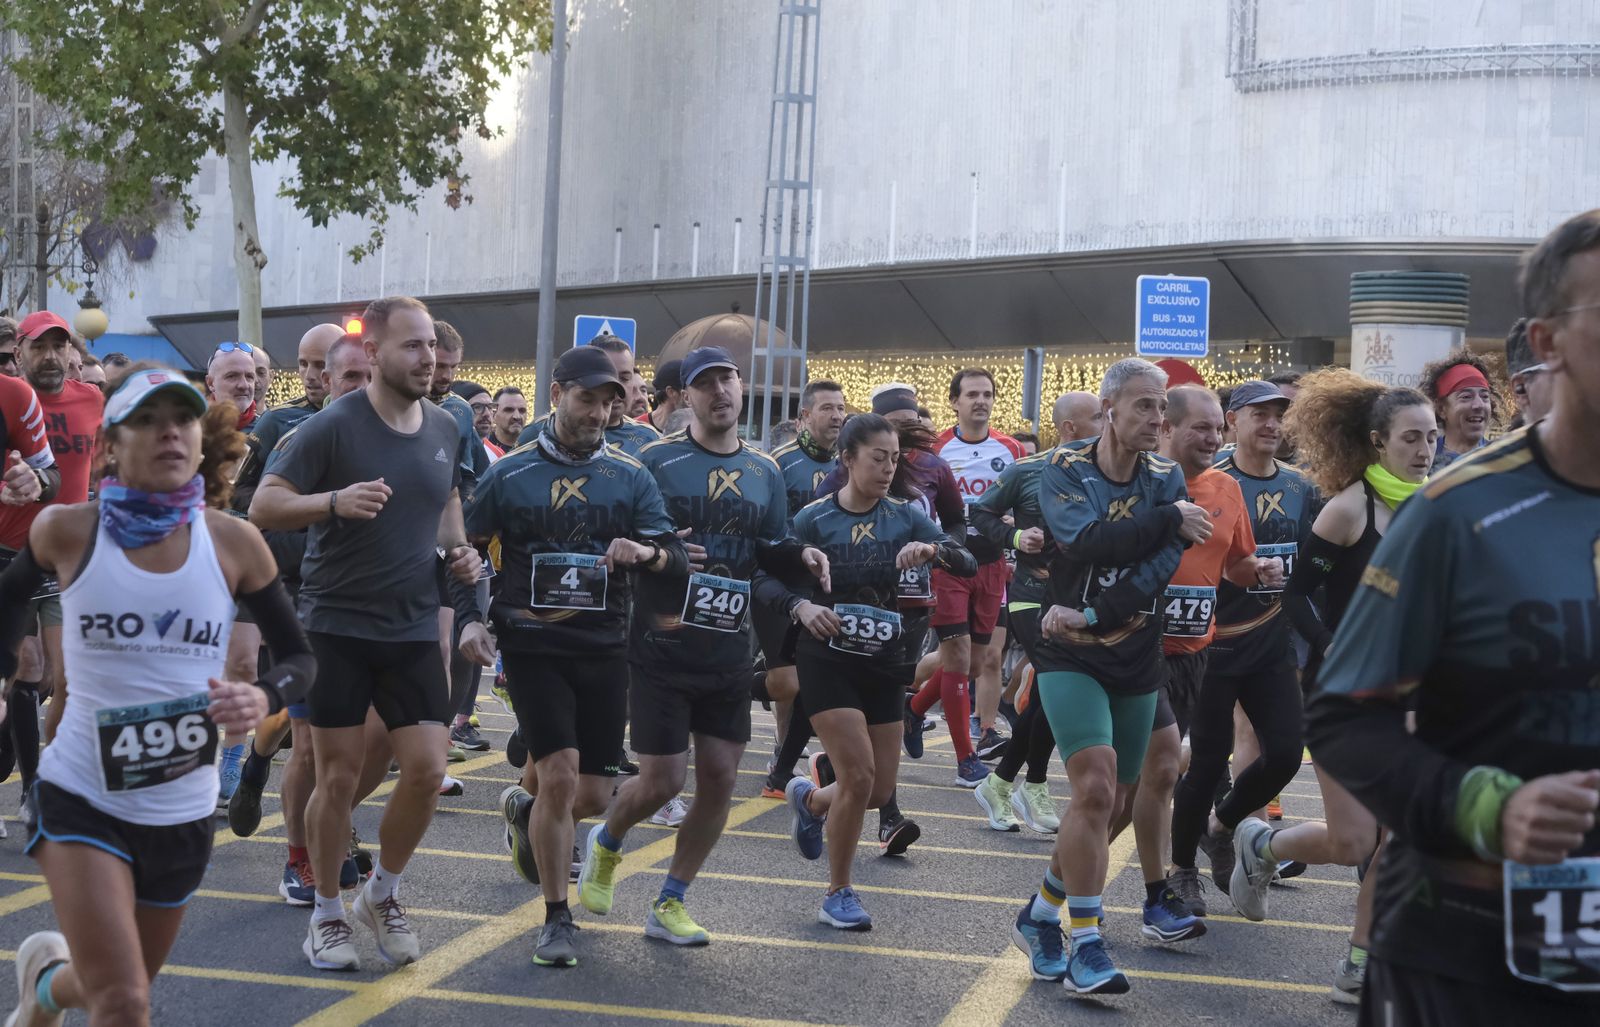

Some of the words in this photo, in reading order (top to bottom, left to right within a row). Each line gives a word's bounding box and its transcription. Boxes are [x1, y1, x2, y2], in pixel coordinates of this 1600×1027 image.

[1156, 282, 1192, 293] CARRIL
[1147, 295, 1200, 306] EXCLUSIVO
[1152, 313, 1171, 322] BUS
[1177, 314, 1195, 323] TAXI
[1141, 327, 1198, 337] AUTORIZADOS
[1199, 329, 1206, 337] Y
[1141, 341, 1205, 352] MOTOCICLETAS
[1383, 373, 1394, 386] DE
[596, 464, 617, 479] SIG
[745, 459, 763, 477] SIG
[550, 476, 590, 512] IX
[707, 466, 744, 503] IX
[1286, 479, 1300, 494] SIG
[1256, 489, 1286, 525] IX
[851, 521, 877, 546] IX
[560, 567, 580, 590] 4
[694, 586, 745, 615] 240
[1165, 598, 1212, 620] 479
[840, 614, 893, 641] 333
[146, 644, 191, 655] urbano
[111, 713, 209, 762] 496
[1532, 890, 1600, 945] 15
